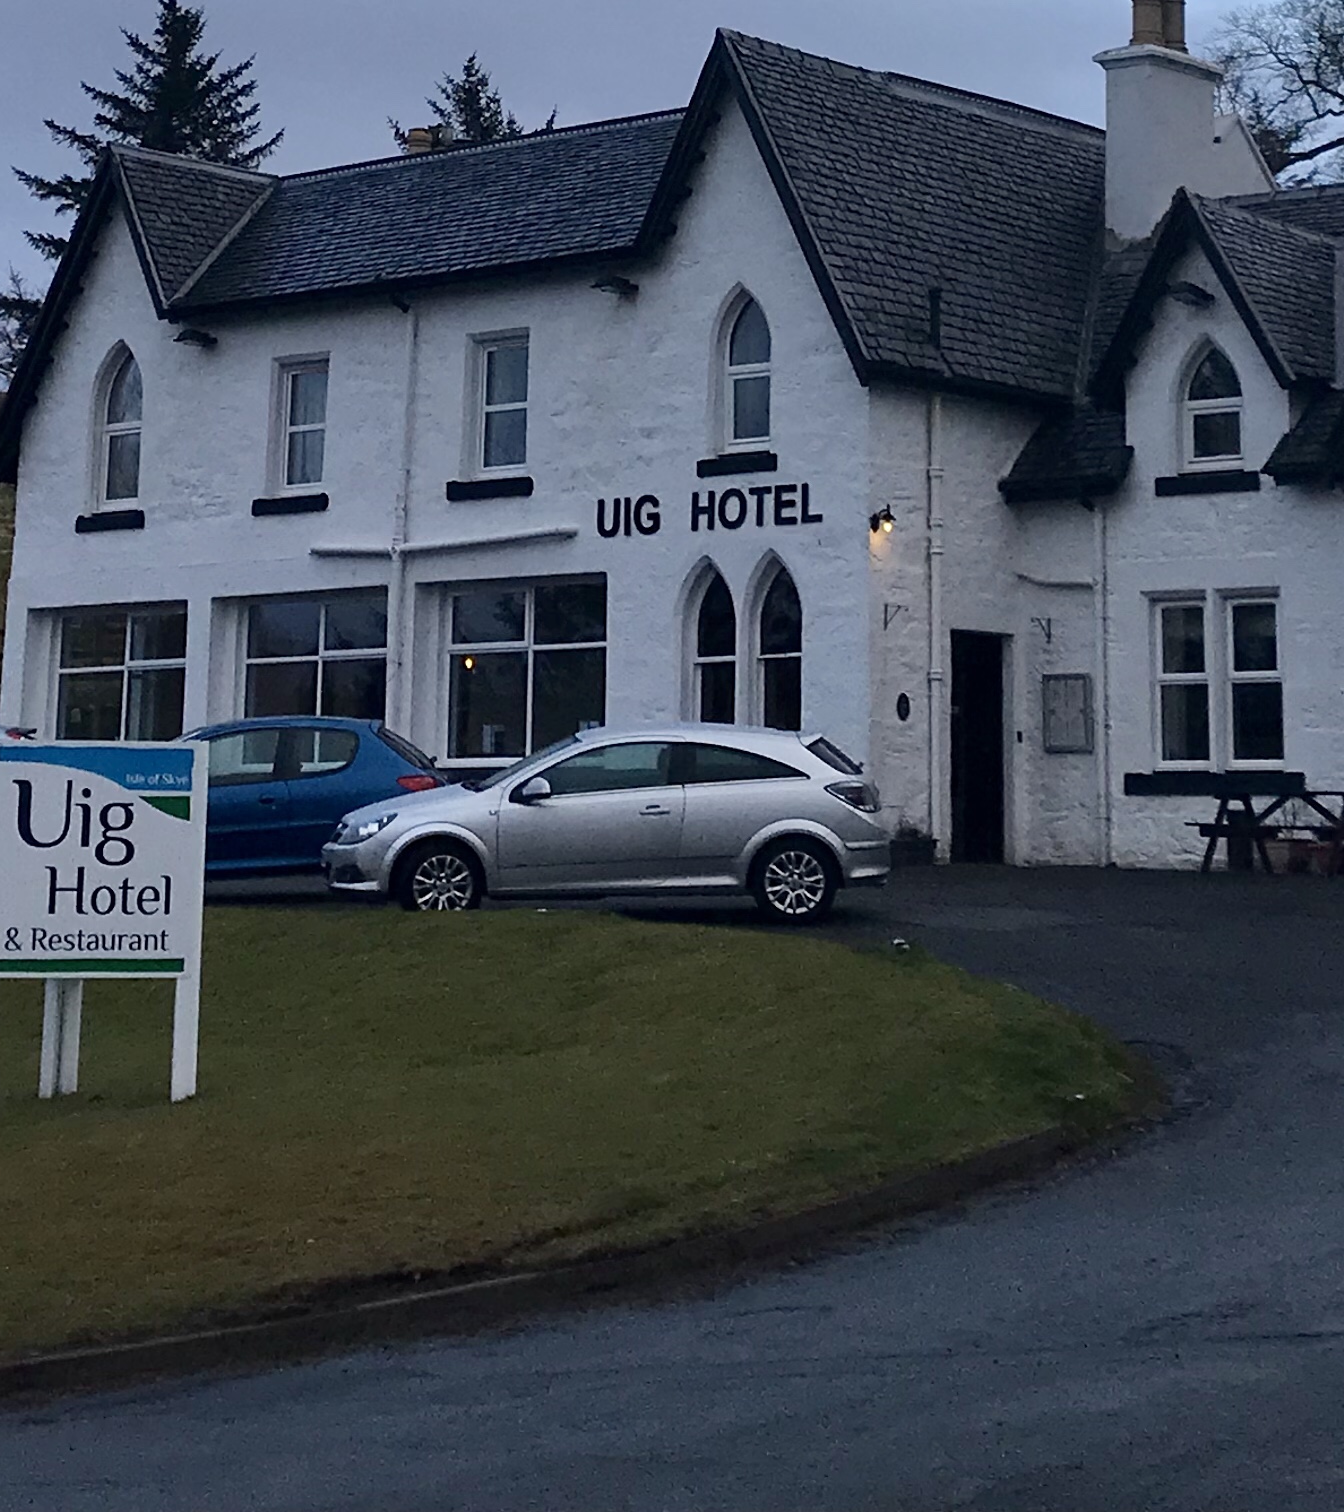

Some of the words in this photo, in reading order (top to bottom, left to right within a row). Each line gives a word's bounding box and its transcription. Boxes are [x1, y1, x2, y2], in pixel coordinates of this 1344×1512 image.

[596, 494, 661, 538] UIG
[690, 482, 823, 532] HOTEL
[125, 772, 146, 785] Isle
[147, 772, 160, 786] of
[12, 779, 136, 867] Uig
[44, 865, 172, 916] Hotel
[4, 926, 23, 952] &
[30, 926, 170, 952] Restaurant
